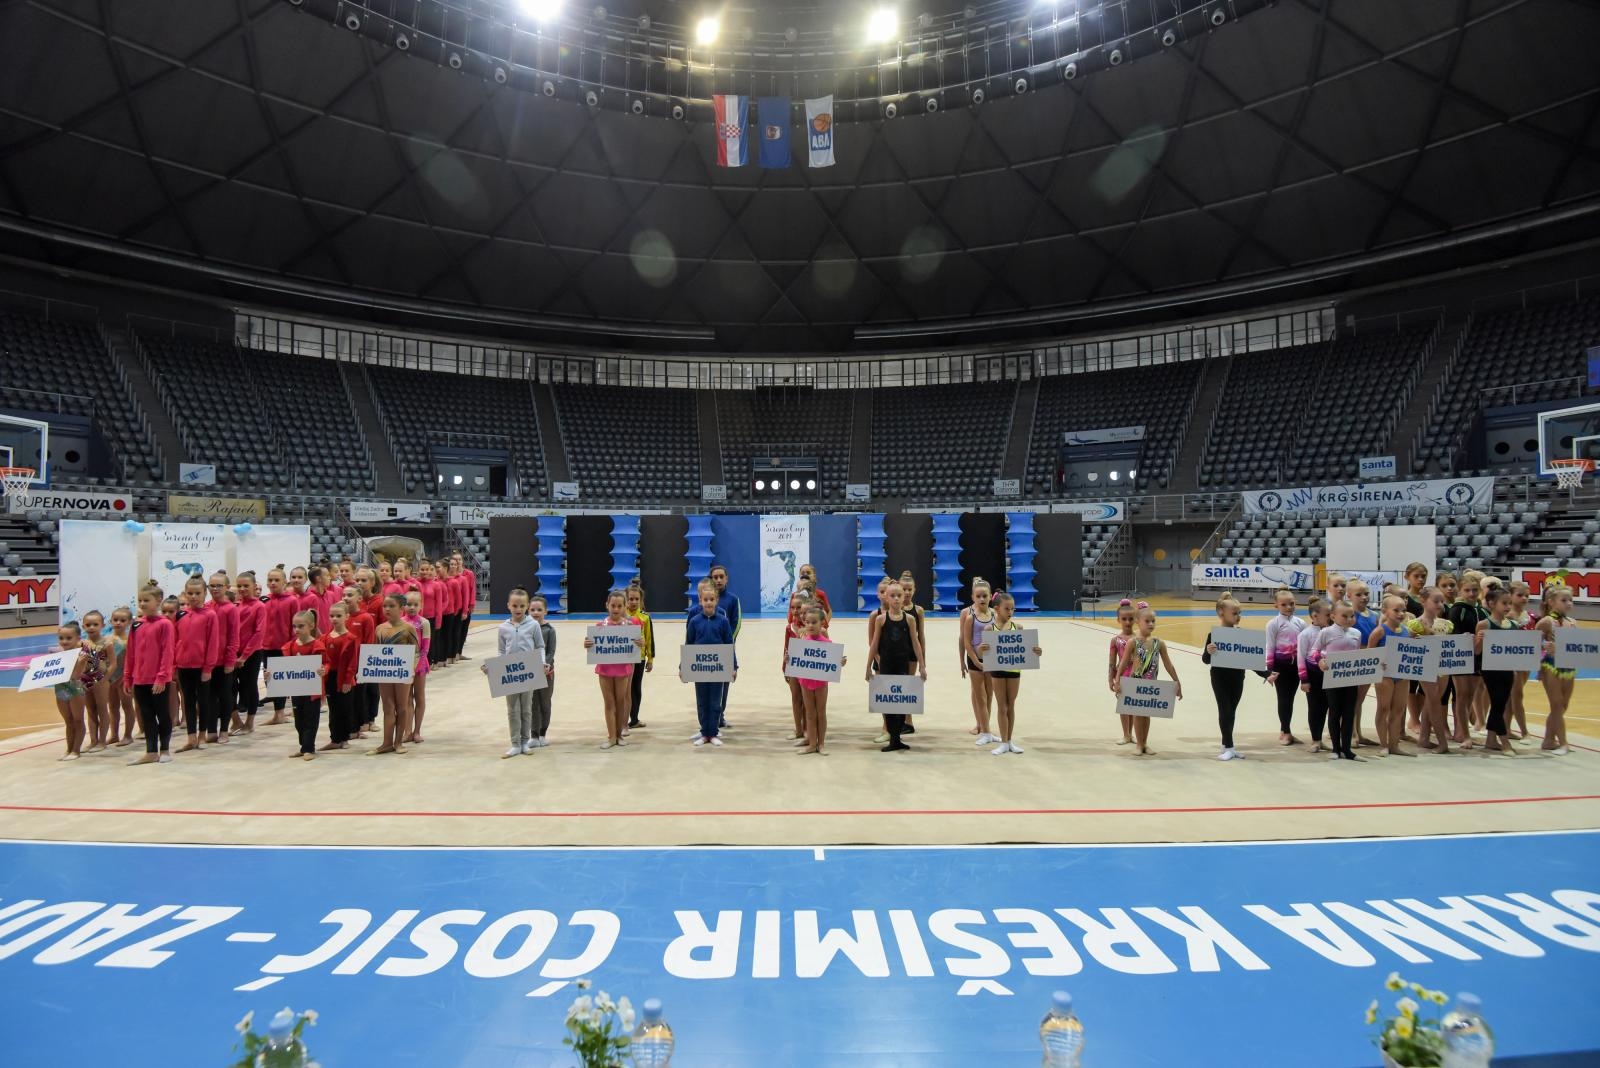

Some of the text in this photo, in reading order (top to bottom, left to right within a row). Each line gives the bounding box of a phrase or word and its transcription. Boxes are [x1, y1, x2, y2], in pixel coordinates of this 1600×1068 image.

[812, 135, 830, 149] ABA
[1362, 460, 1393, 470] santa
[1319, 491, 1403, 502] KRG SIRENA
[16, 496, 111, 510] SUPERNOVA
[1205, 565, 1250, 579] santa
[593, 636, 605, 645] TV
[606, 635, 629, 644] Wien
[381, 647, 394, 656] GK
[595, 644, 634, 655] Mariahilf
[803, 647, 827, 658] KRŠG
[996, 644, 1026, 654] Rondo
[1233, 644, 1264, 655] Pirueta
[1397, 643, 1430, 654] Római-
[1441, 649, 1473, 657] dni dom
[1490, 643, 1535, 655] ŠD MOSTE
[1566, 643, 1583, 653] KRG
[44, 658, 62, 668] KRG
[366, 656, 406, 667] Šibenik-
[997, 654, 1026, 666] Osijek
[1331, 657, 1380, 670] KMG ARGO
[1401, 654, 1423, 664] Parti
[505, 662, 526, 674] KRG
[690, 662, 724, 673] Olimpik
[790, 657, 837, 673] Floramye
[1397, 664, 1424, 675] RG SE
[32, 666, 65, 681] Sirena
[272, 670, 316, 681] GK Vindija
[362, 668, 409, 679] Dalmacija
[501, 672, 535, 685] Allegro
[1332, 668, 1376, 678] Prievidza
[890, 685, 902, 693] GK
[875, 694, 918, 704] MAKSIMIR
[1123, 696, 1169, 710] Rusulice
[0, 899, 245, 969] ZAD
[233, 908, 622, 997] ĆOSIĆ
[663, 904, 1271, 996] KREŠIMIR
